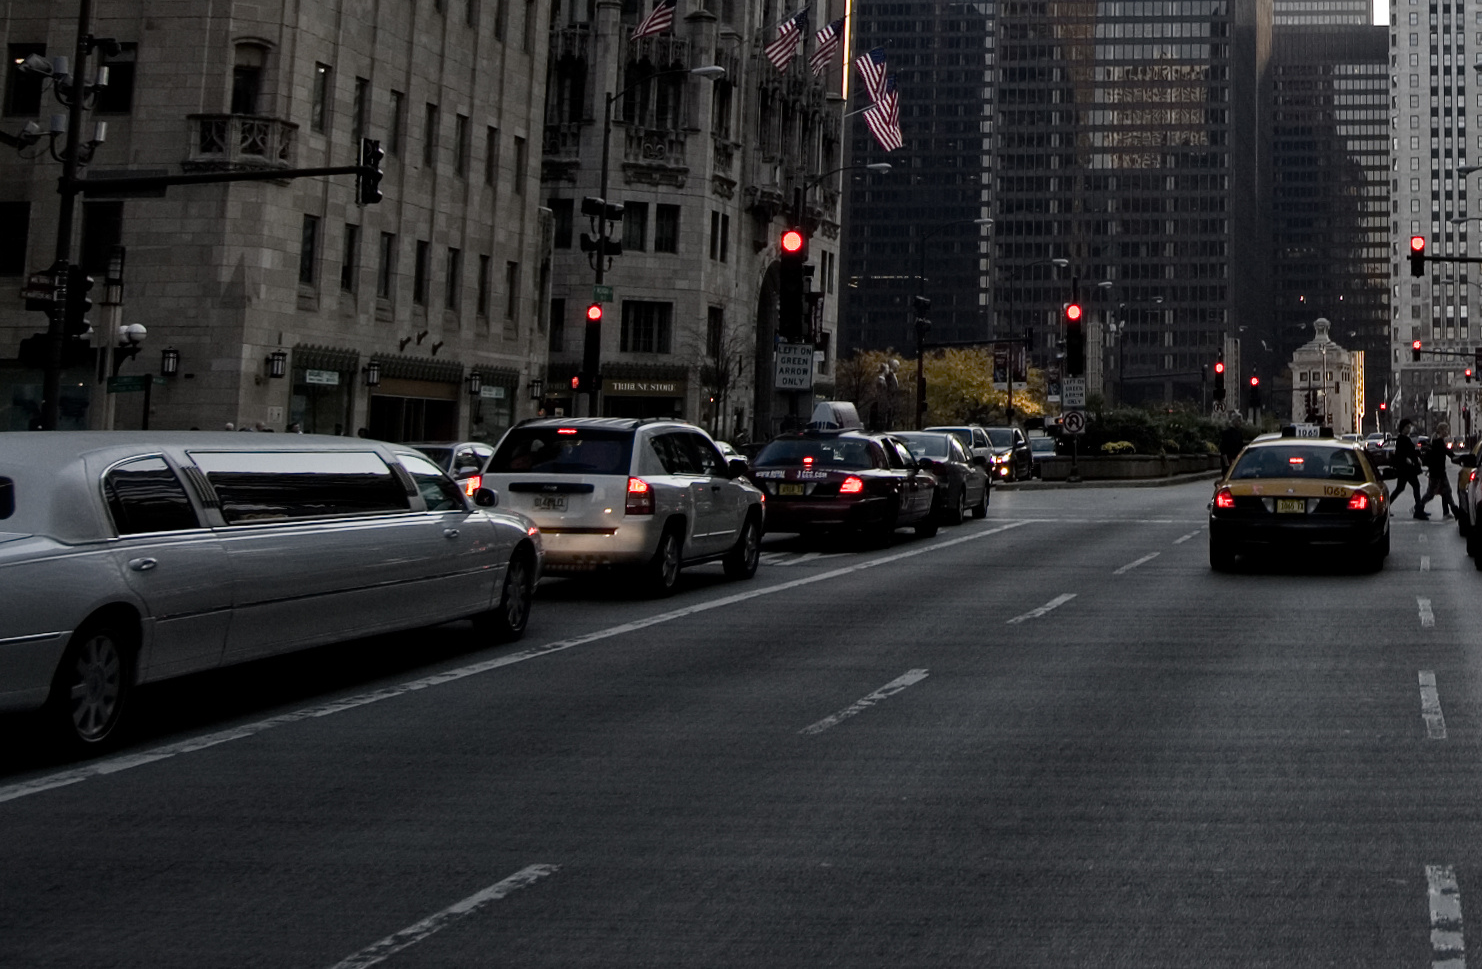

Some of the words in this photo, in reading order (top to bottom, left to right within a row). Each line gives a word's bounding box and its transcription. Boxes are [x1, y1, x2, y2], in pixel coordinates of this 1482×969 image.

[778, 347, 798, 355] LEFT
[781, 357, 808, 365] GREEN
[779, 367, 809, 375] ARROW
[782, 377, 805, 386] ONLY
[611, 382, 648, 391] TRIBUNE
[650, 383, 676, 392] STORE
[1298, 428, 1319, 438] 1065
[1323, 486, 1347, 497] 1065
